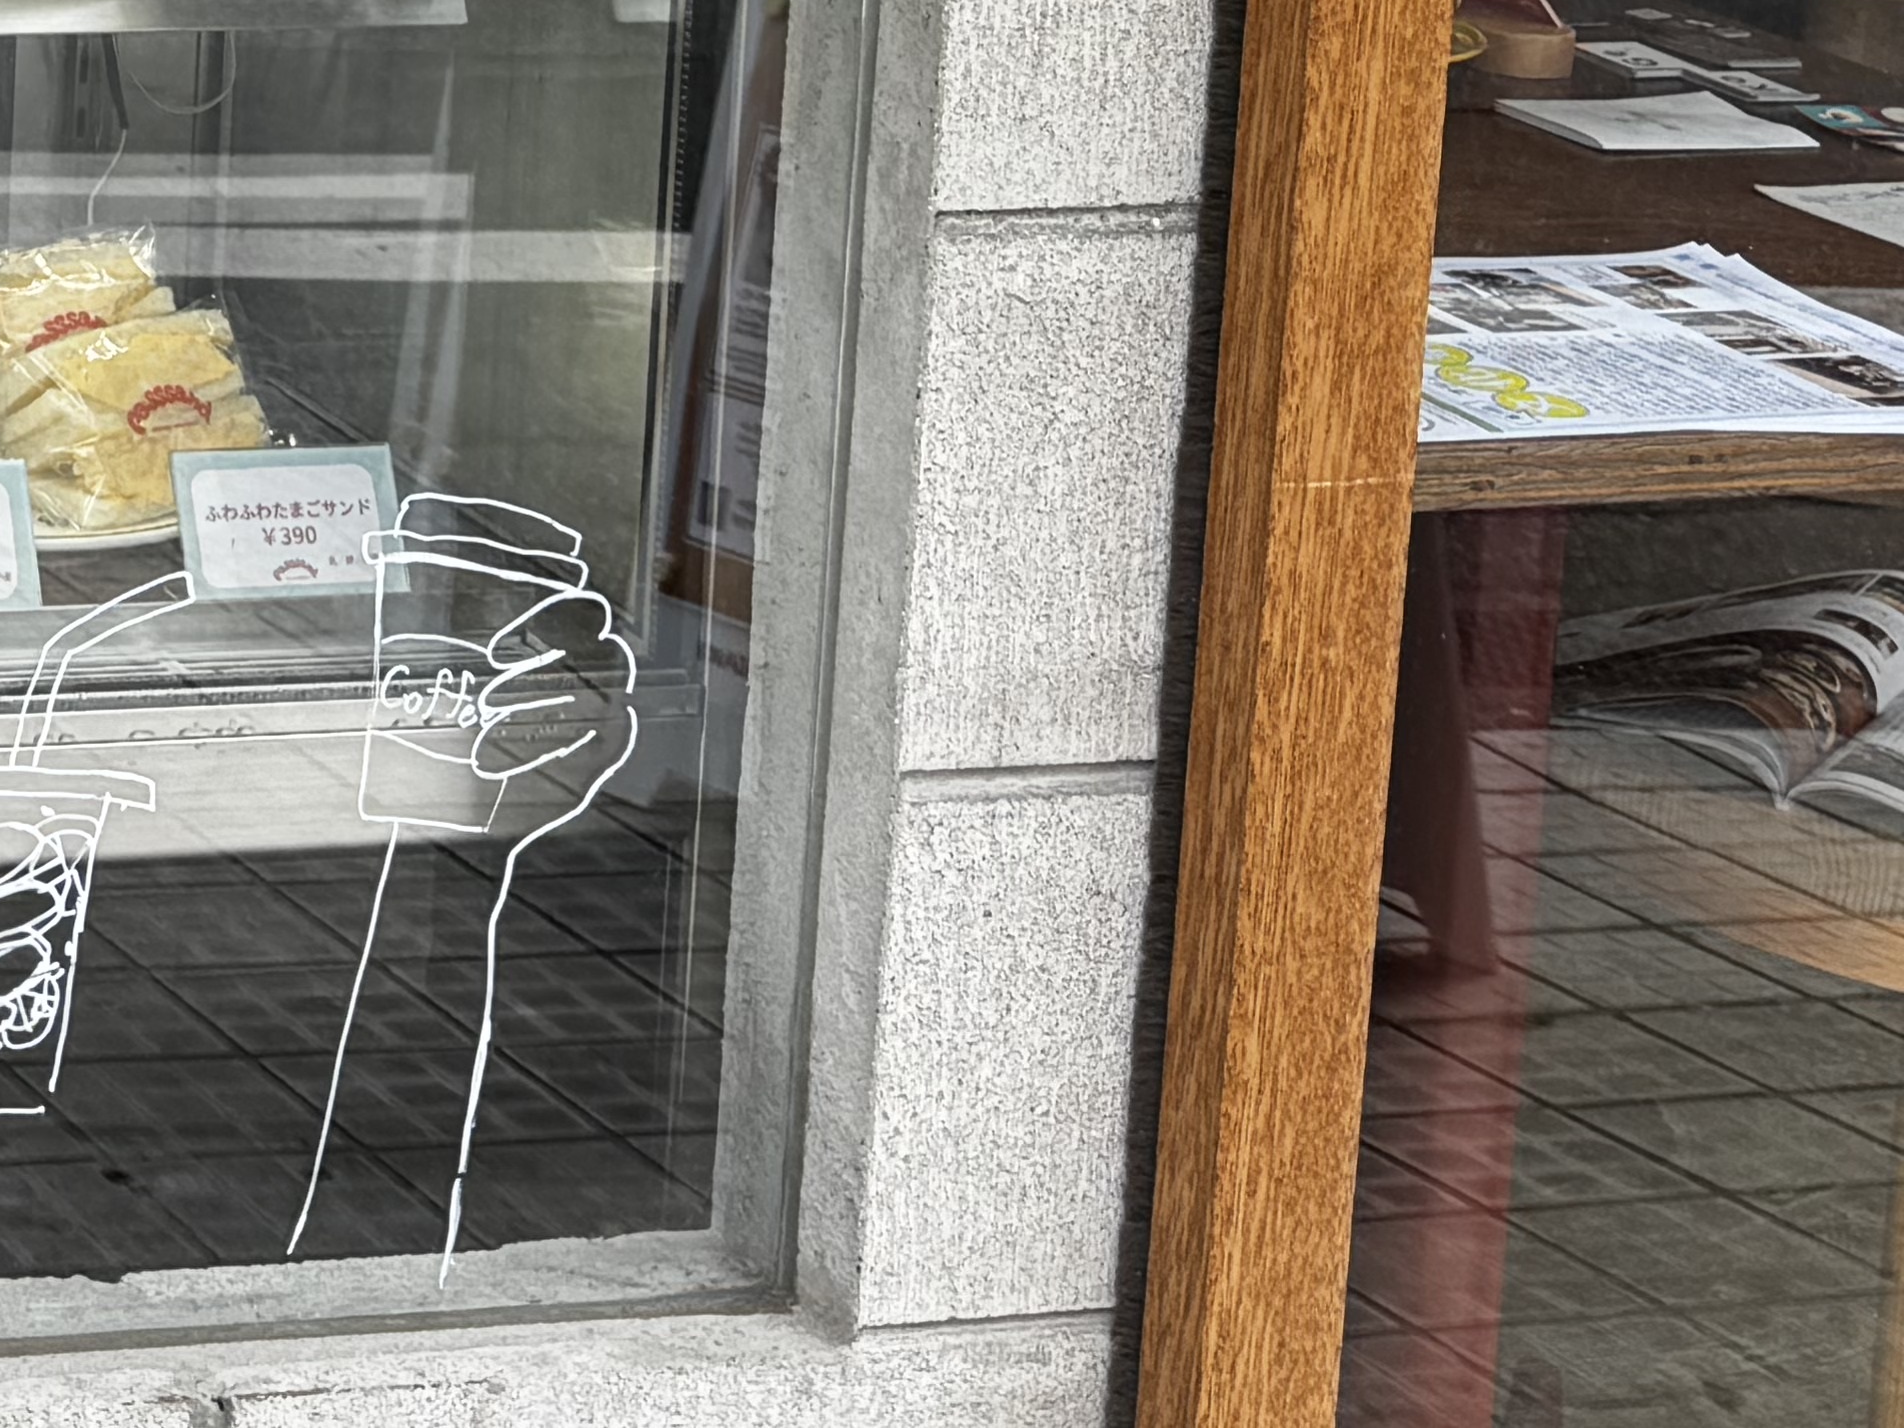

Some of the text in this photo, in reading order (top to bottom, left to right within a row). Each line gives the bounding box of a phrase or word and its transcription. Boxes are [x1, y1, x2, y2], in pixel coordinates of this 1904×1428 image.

[206, 498, 371, 522] ふわふわたまごサンド
[262, 525, 317, 545] ¥390
